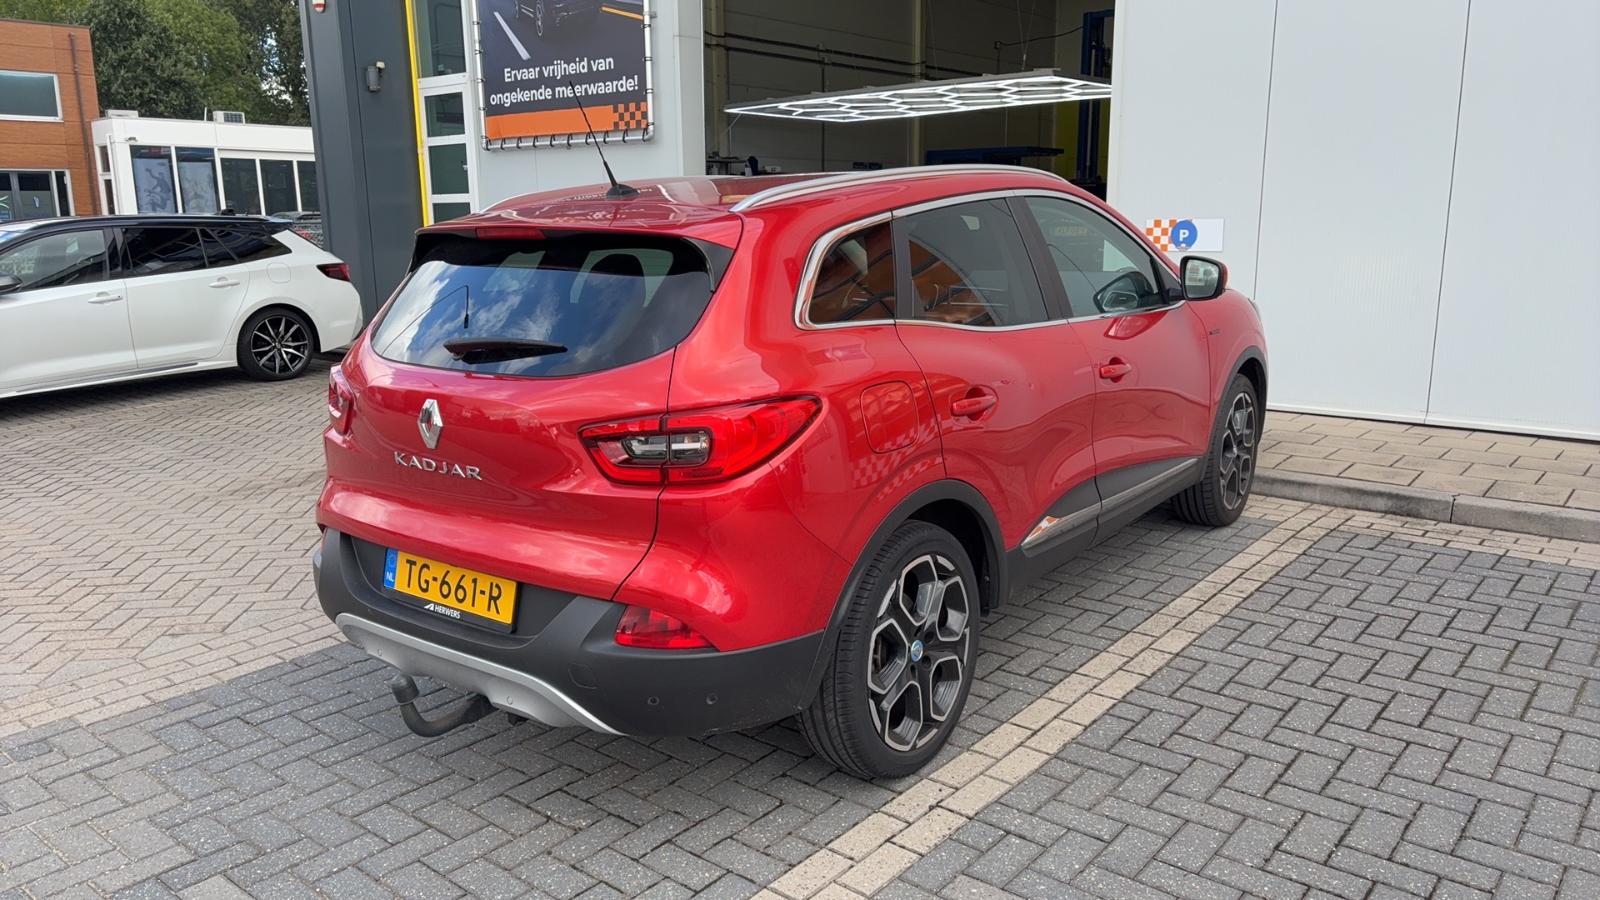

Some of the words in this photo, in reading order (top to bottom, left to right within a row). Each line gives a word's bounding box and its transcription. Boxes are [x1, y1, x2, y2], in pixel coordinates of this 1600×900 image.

[504, 66, 540, 82] Ervaar
[542, 57, 588, 80] vrijheid
[591, 57, 614, 71] van
[490, 85, 552, 107] ongekende
[555, 75, 639, 99] meerwaarde!
[1179, 229, 1190, 242] P
[394, 451, 482, 480] KADJAR
[386, 571, 394, 582] NL
[405, 559, 502, 614] TG-661-R
[435, 604, 461, 619] HERWERS
